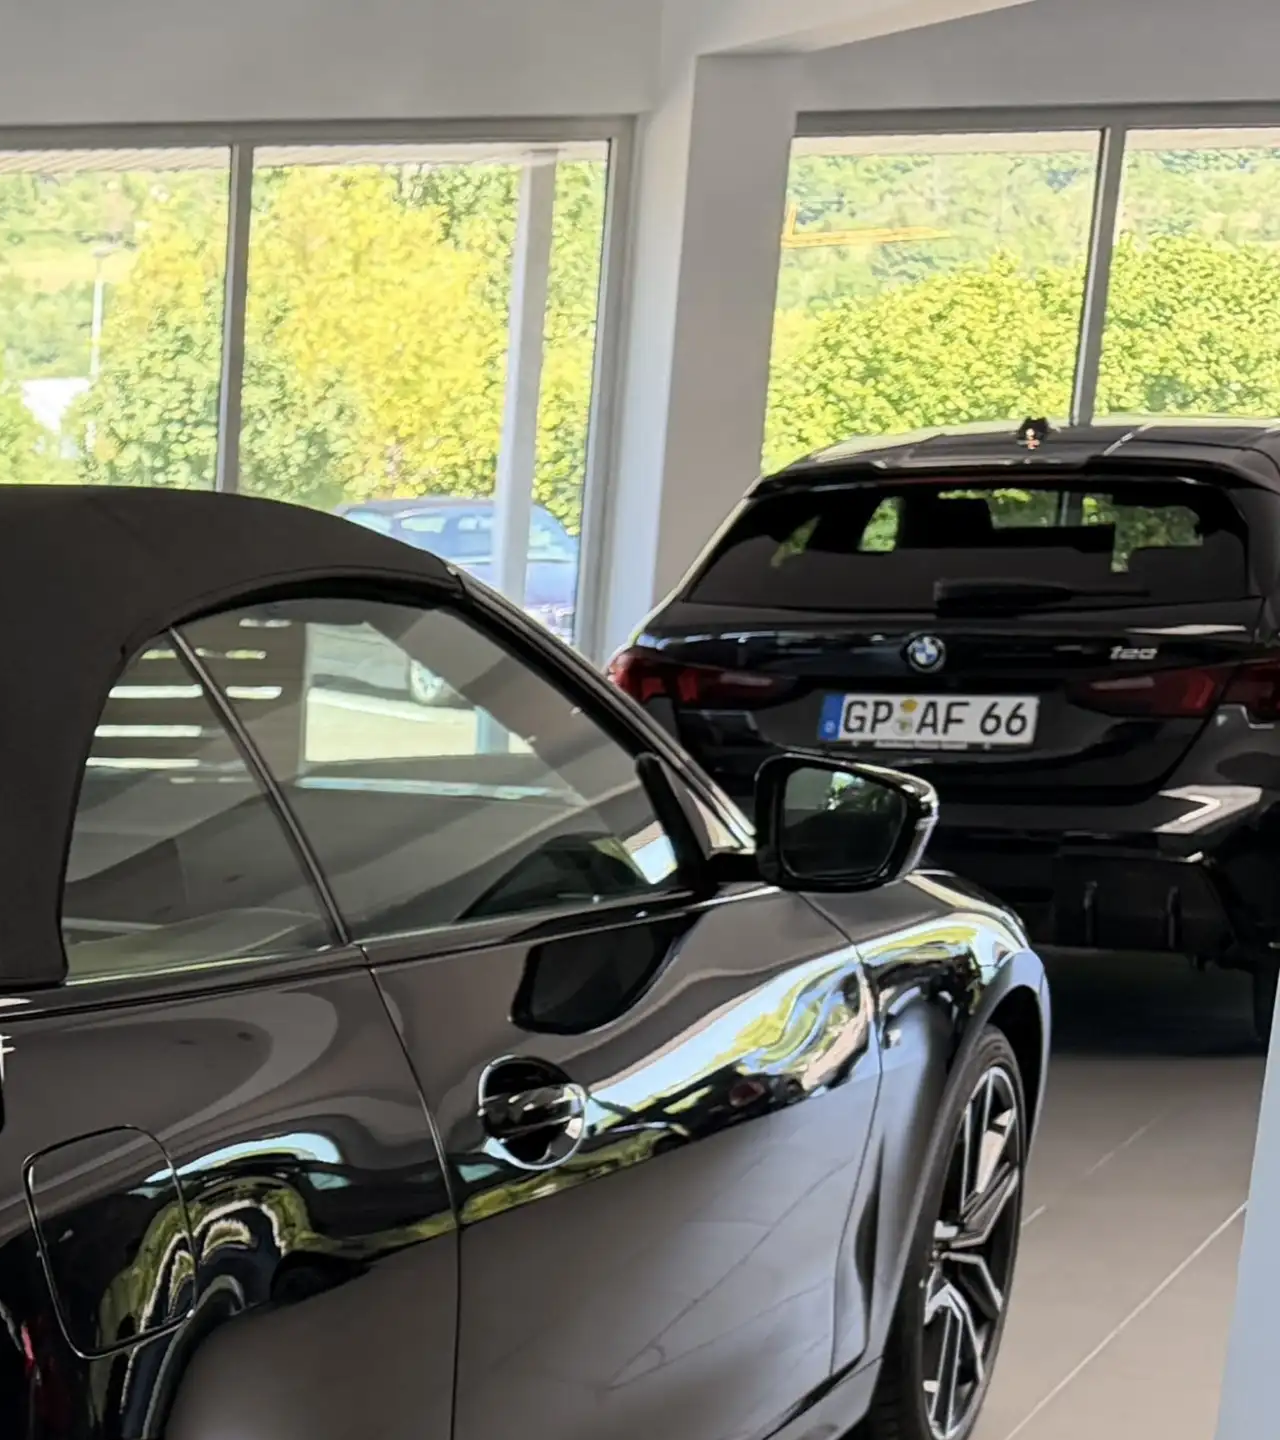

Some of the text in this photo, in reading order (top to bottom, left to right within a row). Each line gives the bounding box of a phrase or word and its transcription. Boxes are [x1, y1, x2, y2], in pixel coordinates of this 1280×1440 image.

[843, 699, 1028, 737] GP AF 66
